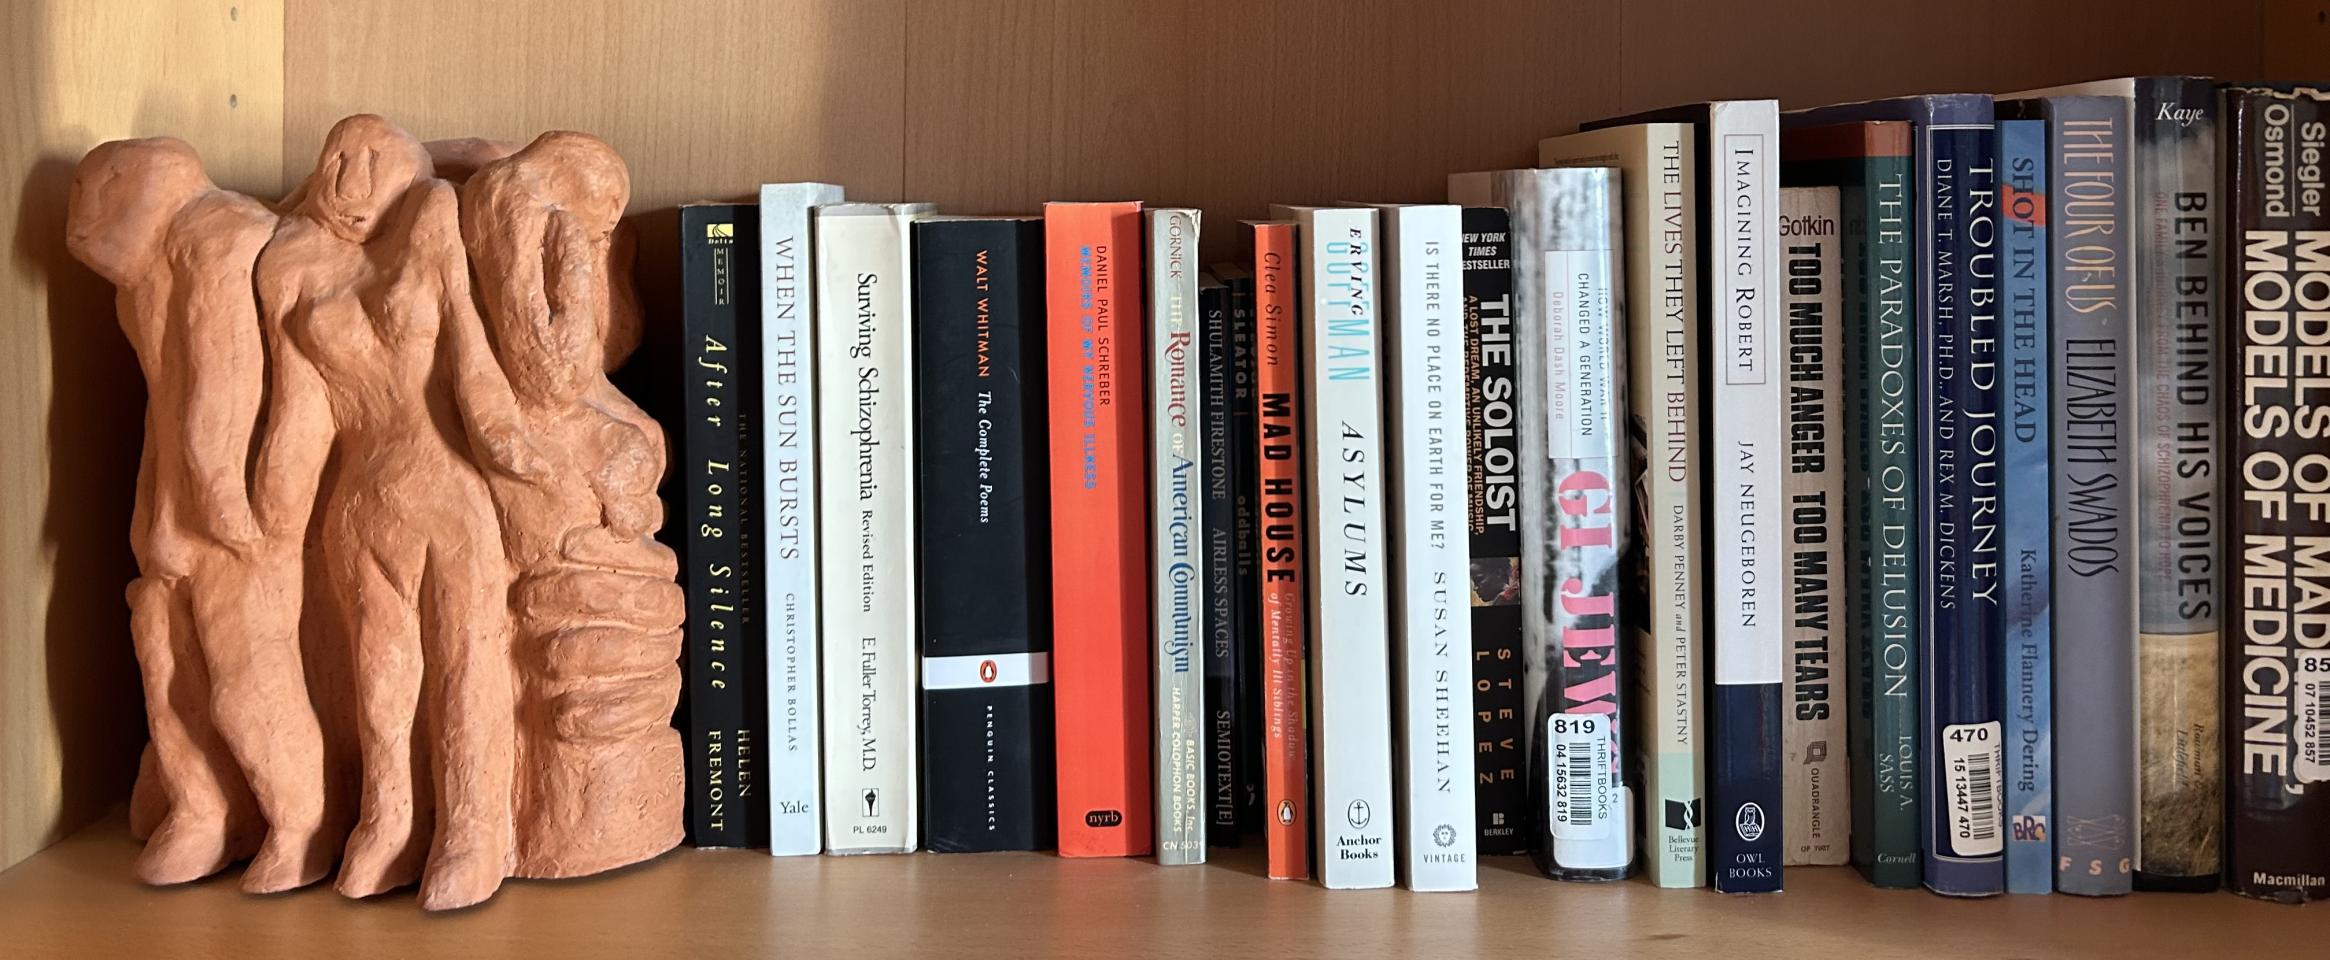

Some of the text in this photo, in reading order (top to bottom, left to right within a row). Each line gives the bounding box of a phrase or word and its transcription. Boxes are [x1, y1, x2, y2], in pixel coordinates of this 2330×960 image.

[2155, 103, 2204, 128] Kaye
[2264, 104, 2289, 217] Osmond
[2297, 122, 2326, 216] Siegler
[1350, 228, 1363, 316] ERVING
[1468, 246, 1497, 256] TIMES
[1481, 232, 1506, 242] YORK
[1735, 149, 1756, 372] IMAGINING ROBERT
[1780, 215, 1834, 236] Gotkin
[2063, 118, 2116, 314] THE FOUR OF US
[976, 250, 989, 377] WALT WHITMAN
[1096, 246, 1110, 405] DANIEL PAUL SCHREBER
[1234, 309, 1247, 398] SLEATOR
[1264, 253, 1281, 366] Clea Simon
[1578, 273, 1590, 334] CHANGED
[1663, 142, 1687, 482] THE LIVES THEY LEFT BEHIND
[2011, 158, 2037, 442] SHOT IN THE HEAD
[776, 237, 799, 560] WHEN THE SUN BURSTS
[1208, 310, 1226, 499] SHULAMITH FIRESTONE
[1425, 242, 1444, 549] IS THERE NO PLACE ON EARTH FOR ME?
[1480, 294, 1516, 531] THE SOLOIST
[1580, 355, 1592, 436] GENERATION
[1962, 159, 1997, 606] TROUBLED JOURNEY
[2175, 192, 2211, 620] BEN BEHIND HIS VOICES
[2293, 231, 2330, 520] MODELS OF
[851, 273, 879, 612] Surviving Schizophrenia Revised Edition
[975, 391, 992, 523] The Complete Poems
[1164, 215, 1195, 672] GORNICK THE Romance OF American Communism
[1262, 393, 1295, 582] MAD HOUSE
[1789, 243, 1829, 721] TOO MUCH ANGER TOO MANY TEARS
[1879, 174, 1908, 697] THE PARADOXES OF DELUSION
[2066, 339, 2119, 577] ELIZABETH SWADOS
[699, 335, 733, 689] After Long Silence
[1237, 496, 1249, 575] oddballs
[1342, 421, 1368, 596] ASYLUMS
[1558, 470, 1612, 550] GI
[1738, 442, 1756, 626] JAY NEUGEBOREN
[2243, 230, 2290, 775] MODELS OF MEDICINE
[1213, 528, 1228, 657] AIRLESS SPACES
[1673, 505, 1688, 744] DARBY PENNEY and PETER STASTNY
[786, 593, 797, 751] CHRISTOPHER BOLLAS
[857, 637, 876, 771] E. Fuller Torrey, M.D.
[1434, 572, 1450, 793] SUSAN SHEEHAN
[1476, 651, 1492, 784] LOPEZ
[1497, 648, 1514, 780] STEVE
[1555, 720, 1595, 733] 819
[2017, 549, 2038, 792] Katherine Flannery Dering
[2304, 684, 2317, 763] 07 10452 857
[709, 731, 724, 831] FREMONT
[737, 730, 751, 797] HELEN
[1215, 711, 1234, 825] SEMIOTEXT[E]
[1556, 744, 1567, 822] 04 15632 819
[1597, 736, 1607, 819] THRIFTBOOKS
[1879, 754, 1893, 792] SASS
[1899, 736, 1912, 810] LOUIS A.
[1950, 728, 1988, 741] 470
[780, 801, 809, 814] Yale
[853, 826, 887, 834] PL 6249
[1089, 814, 1119, 823] nyrb
[1337, 835, 1381, 846] Anchor
[1339, 849, 1378, 859] Books
[1668, 836, 1699, 844] Bellevue
[1668, 845, 1699, 854] Literary
[1811, 768, 1821, 838] QUADRANGLE
[1954, 758, 1970, 839] 15 13447 470
[1424, 855, 1465, 863] VINTAGE
[1674, 855, 1694, 863] Press
[1729, 868, 1772, 878] BOOKS
[1736, 853, 1763, 863] OWL
[2253, 871, 2326, 886] Macmillan
